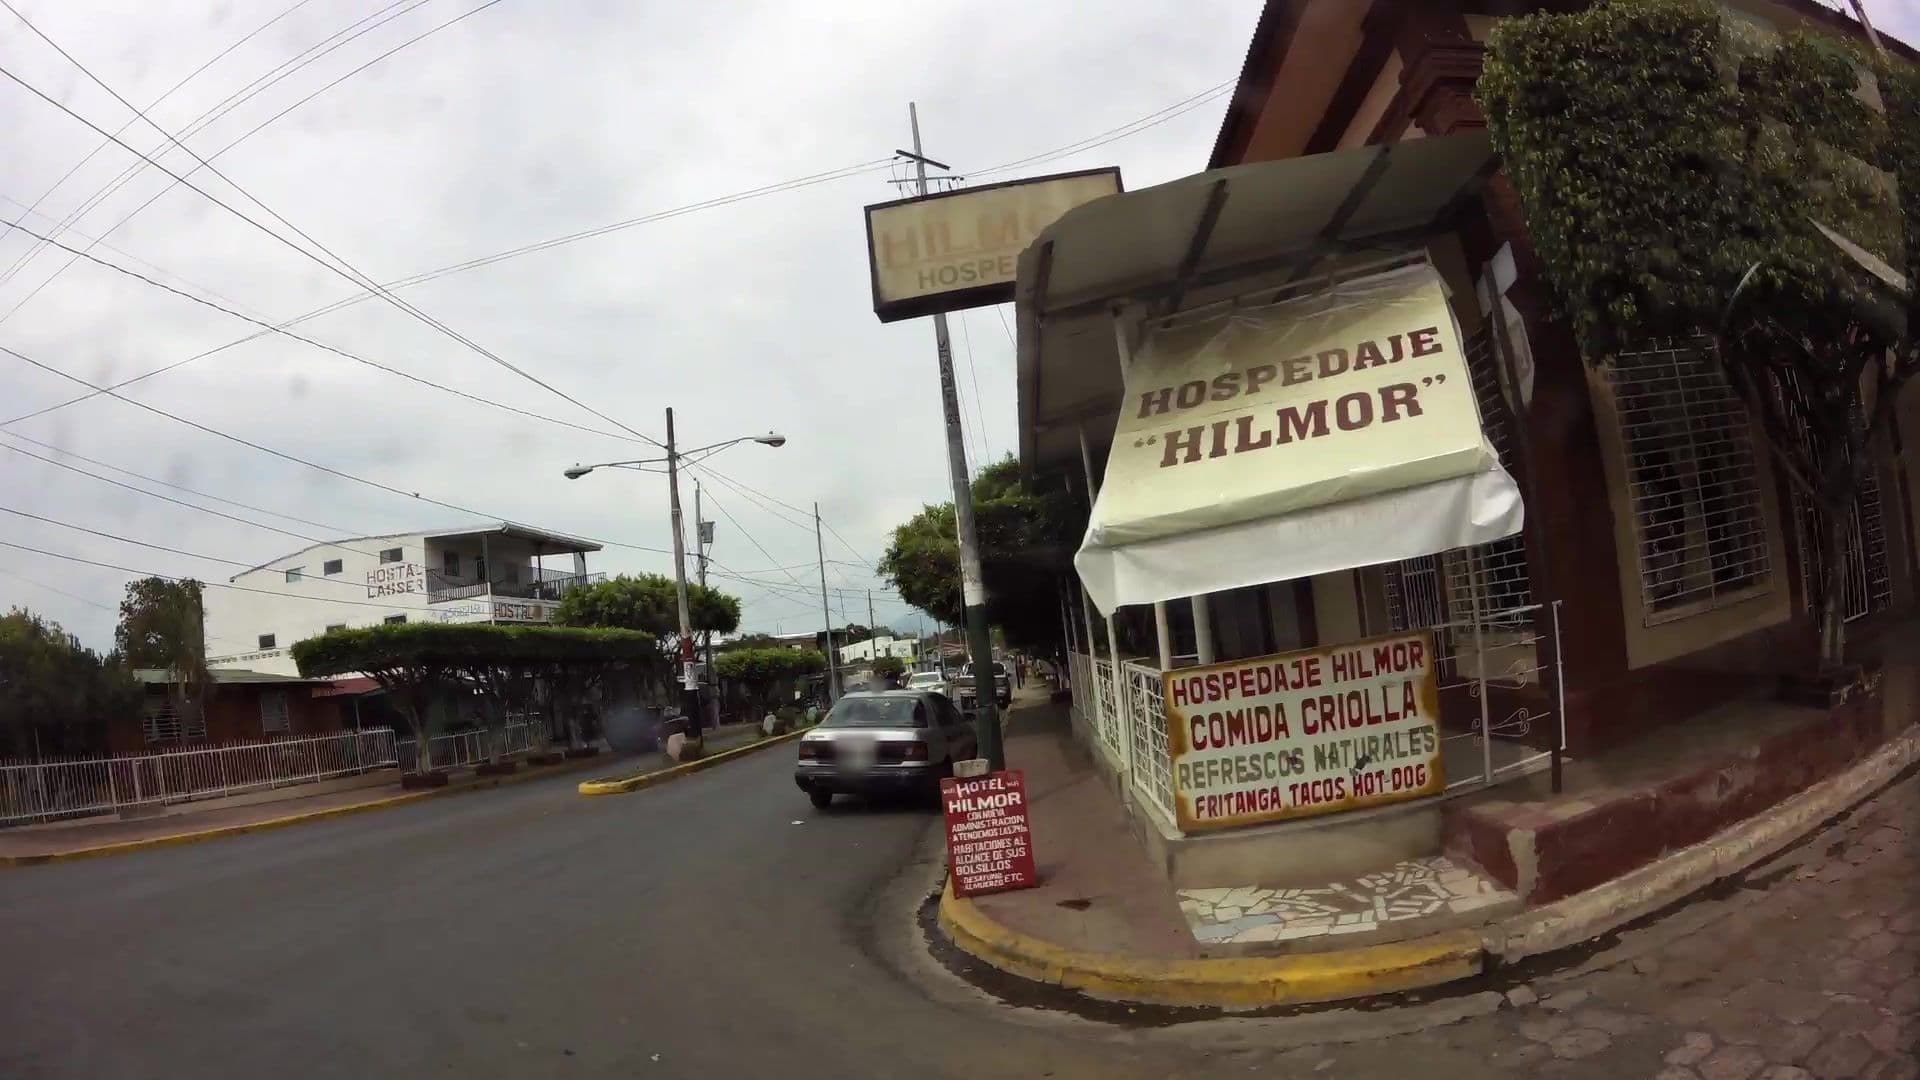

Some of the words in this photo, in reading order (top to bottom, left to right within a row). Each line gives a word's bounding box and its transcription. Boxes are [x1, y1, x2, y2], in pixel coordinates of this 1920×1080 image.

[918, 256, 1016, 289] HOSPE
[1136, 326, 1443, 419] HOSPEDAJE
[1172, 657, 1321, 707] HOSPEDAJE
[1332, 640, 1424, 683] HILMOR
[1190, 702, 1290, 751] COMIDA
[1301, 680, 1418, 735] CRIOLLA
[1178, 747, 1304, 790] REFRESCOS
[1313, 725, 1435, 772] NATURALES
[948, 791, 1022, 814] HILMOR
[956, 778, 1005, 798] HOTEL
[1195, 785, 1281, 819] FRITANGA
[1289, 776, 1345, 808] TACOS
[952, 814, 1025, 833] ADMINISTRACION
[953, 838, 1011, 855] HABITACIONES
[1013, 836, 1027, 847] AL
[956, 851, 990, 866] ALCANCE
[992, 849, 1003, 861] DE
[1006, 847, 1026, 859] SUS
